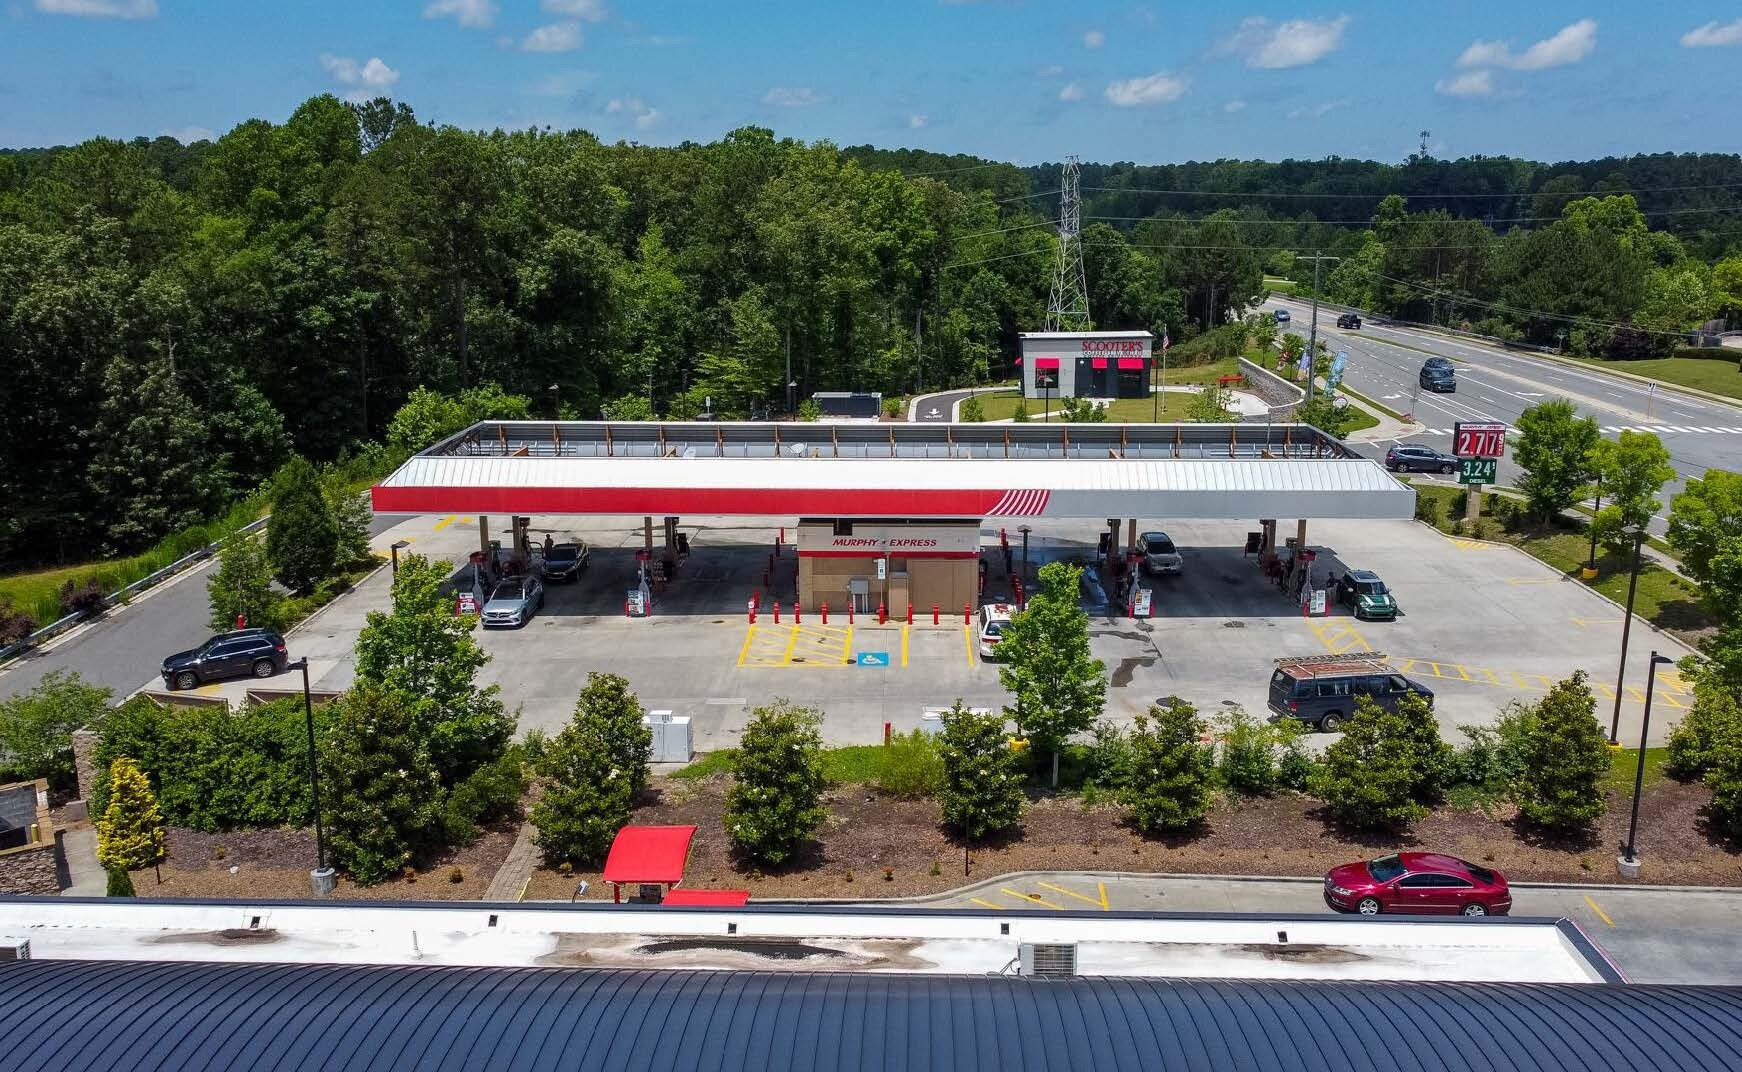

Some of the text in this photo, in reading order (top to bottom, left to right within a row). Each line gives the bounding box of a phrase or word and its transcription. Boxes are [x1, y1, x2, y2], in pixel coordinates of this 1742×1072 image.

[1082, 340, 1143, 351] SCOOTER'S
[832, 539, 937, 547] MURPHY EXPRESS
